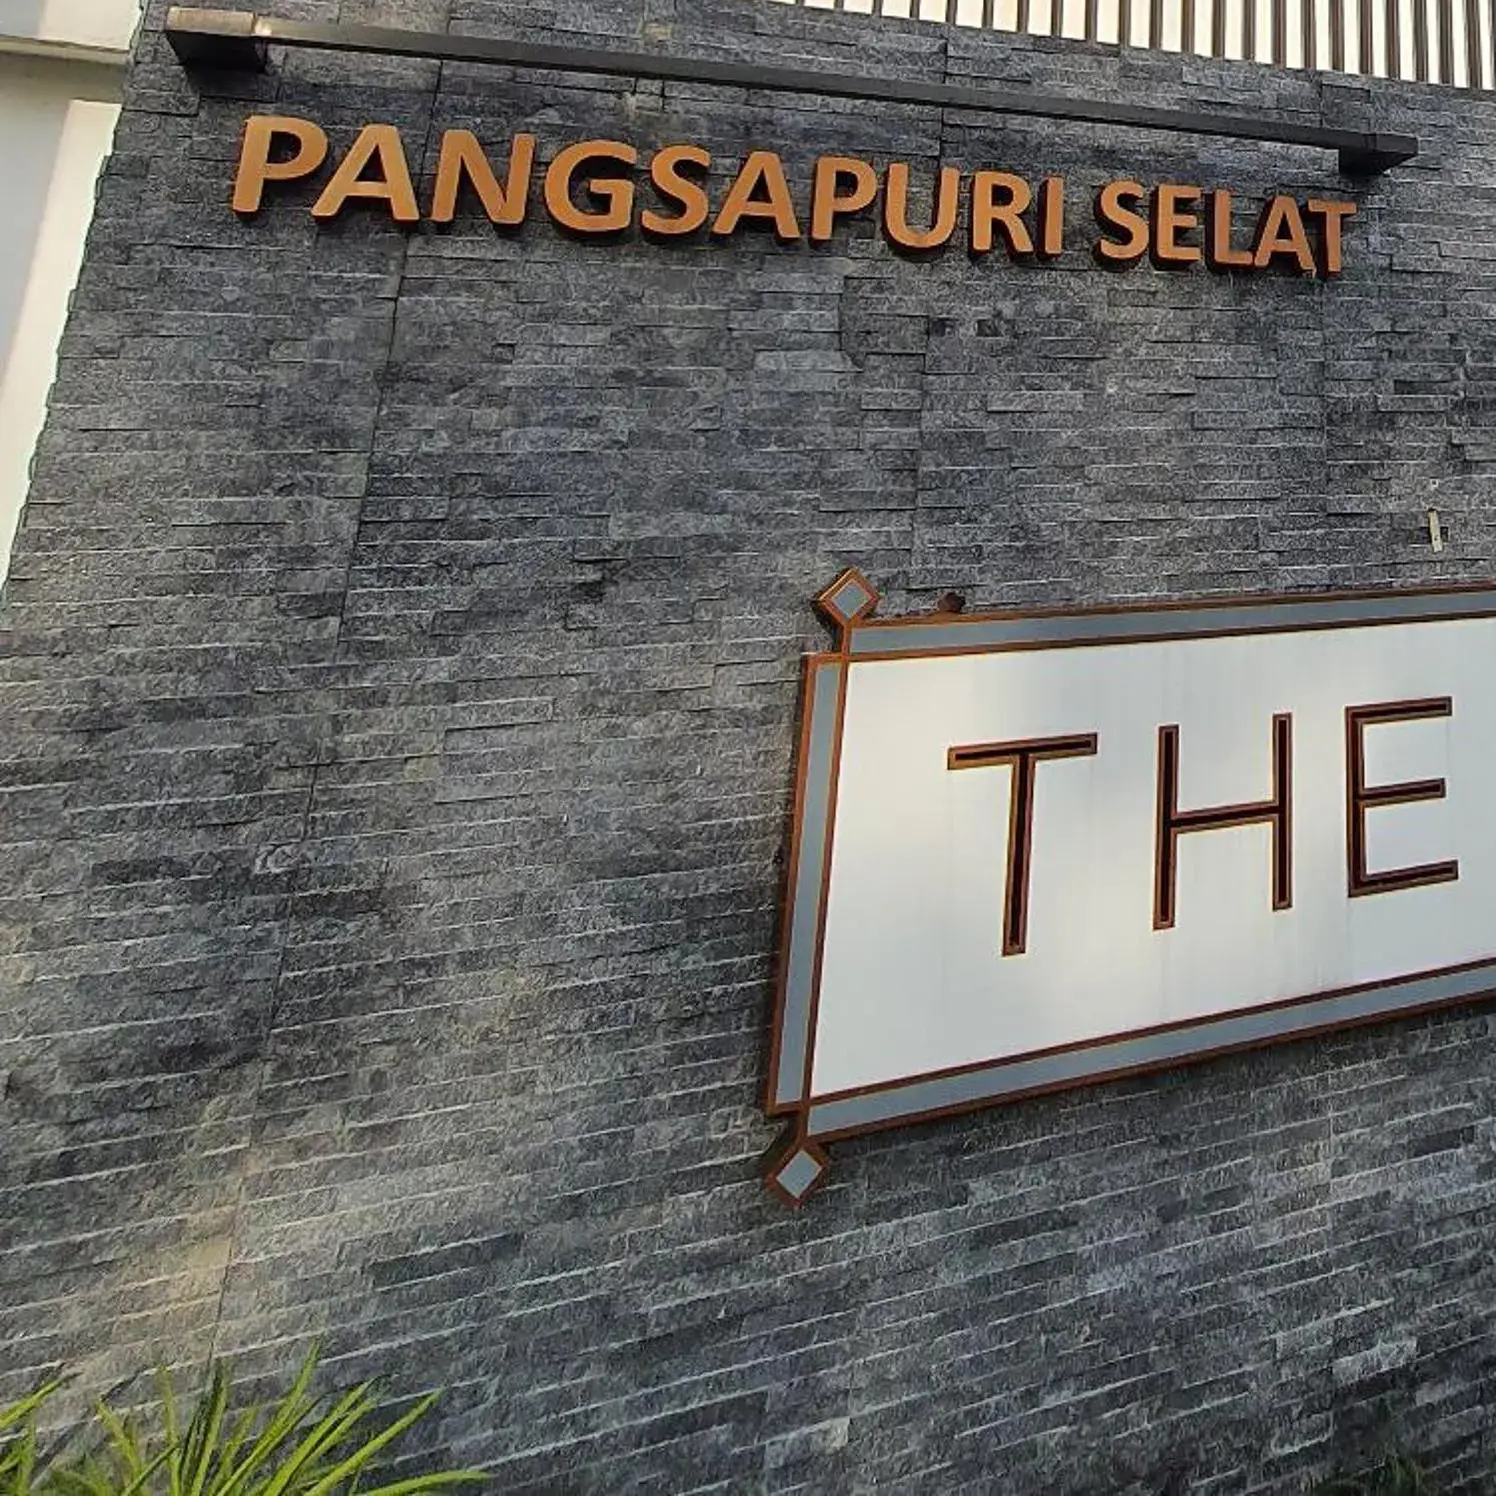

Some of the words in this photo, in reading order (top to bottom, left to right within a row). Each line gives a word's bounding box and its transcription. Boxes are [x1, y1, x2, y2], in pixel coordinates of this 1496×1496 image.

[231, 114, 1066, 256] PANGSAPURI
[1095, 179, 1357, 276] SELAT
[947, 695, 1460, 957] THE
